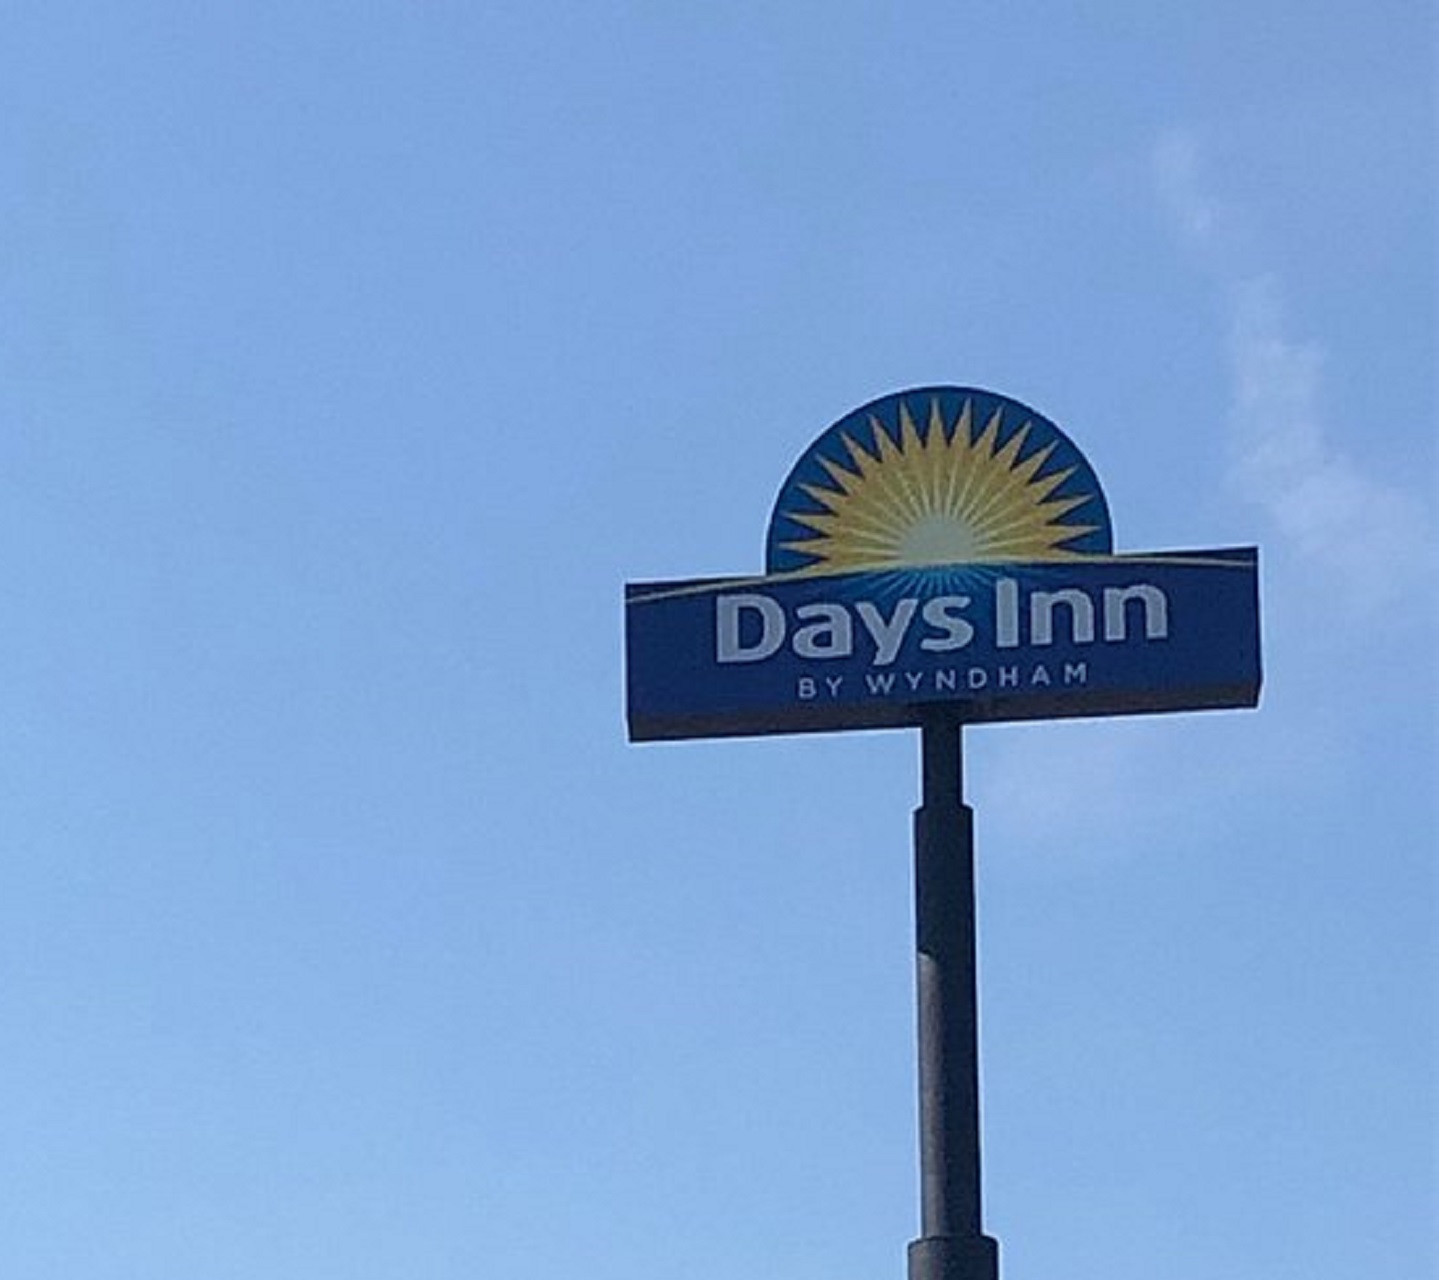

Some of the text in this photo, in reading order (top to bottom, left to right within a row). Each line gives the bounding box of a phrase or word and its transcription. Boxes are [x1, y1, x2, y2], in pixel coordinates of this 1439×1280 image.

[715, 577, 1168, 666] Days Inn
[797, 661, 1088, 699] BY WYNDHAM
